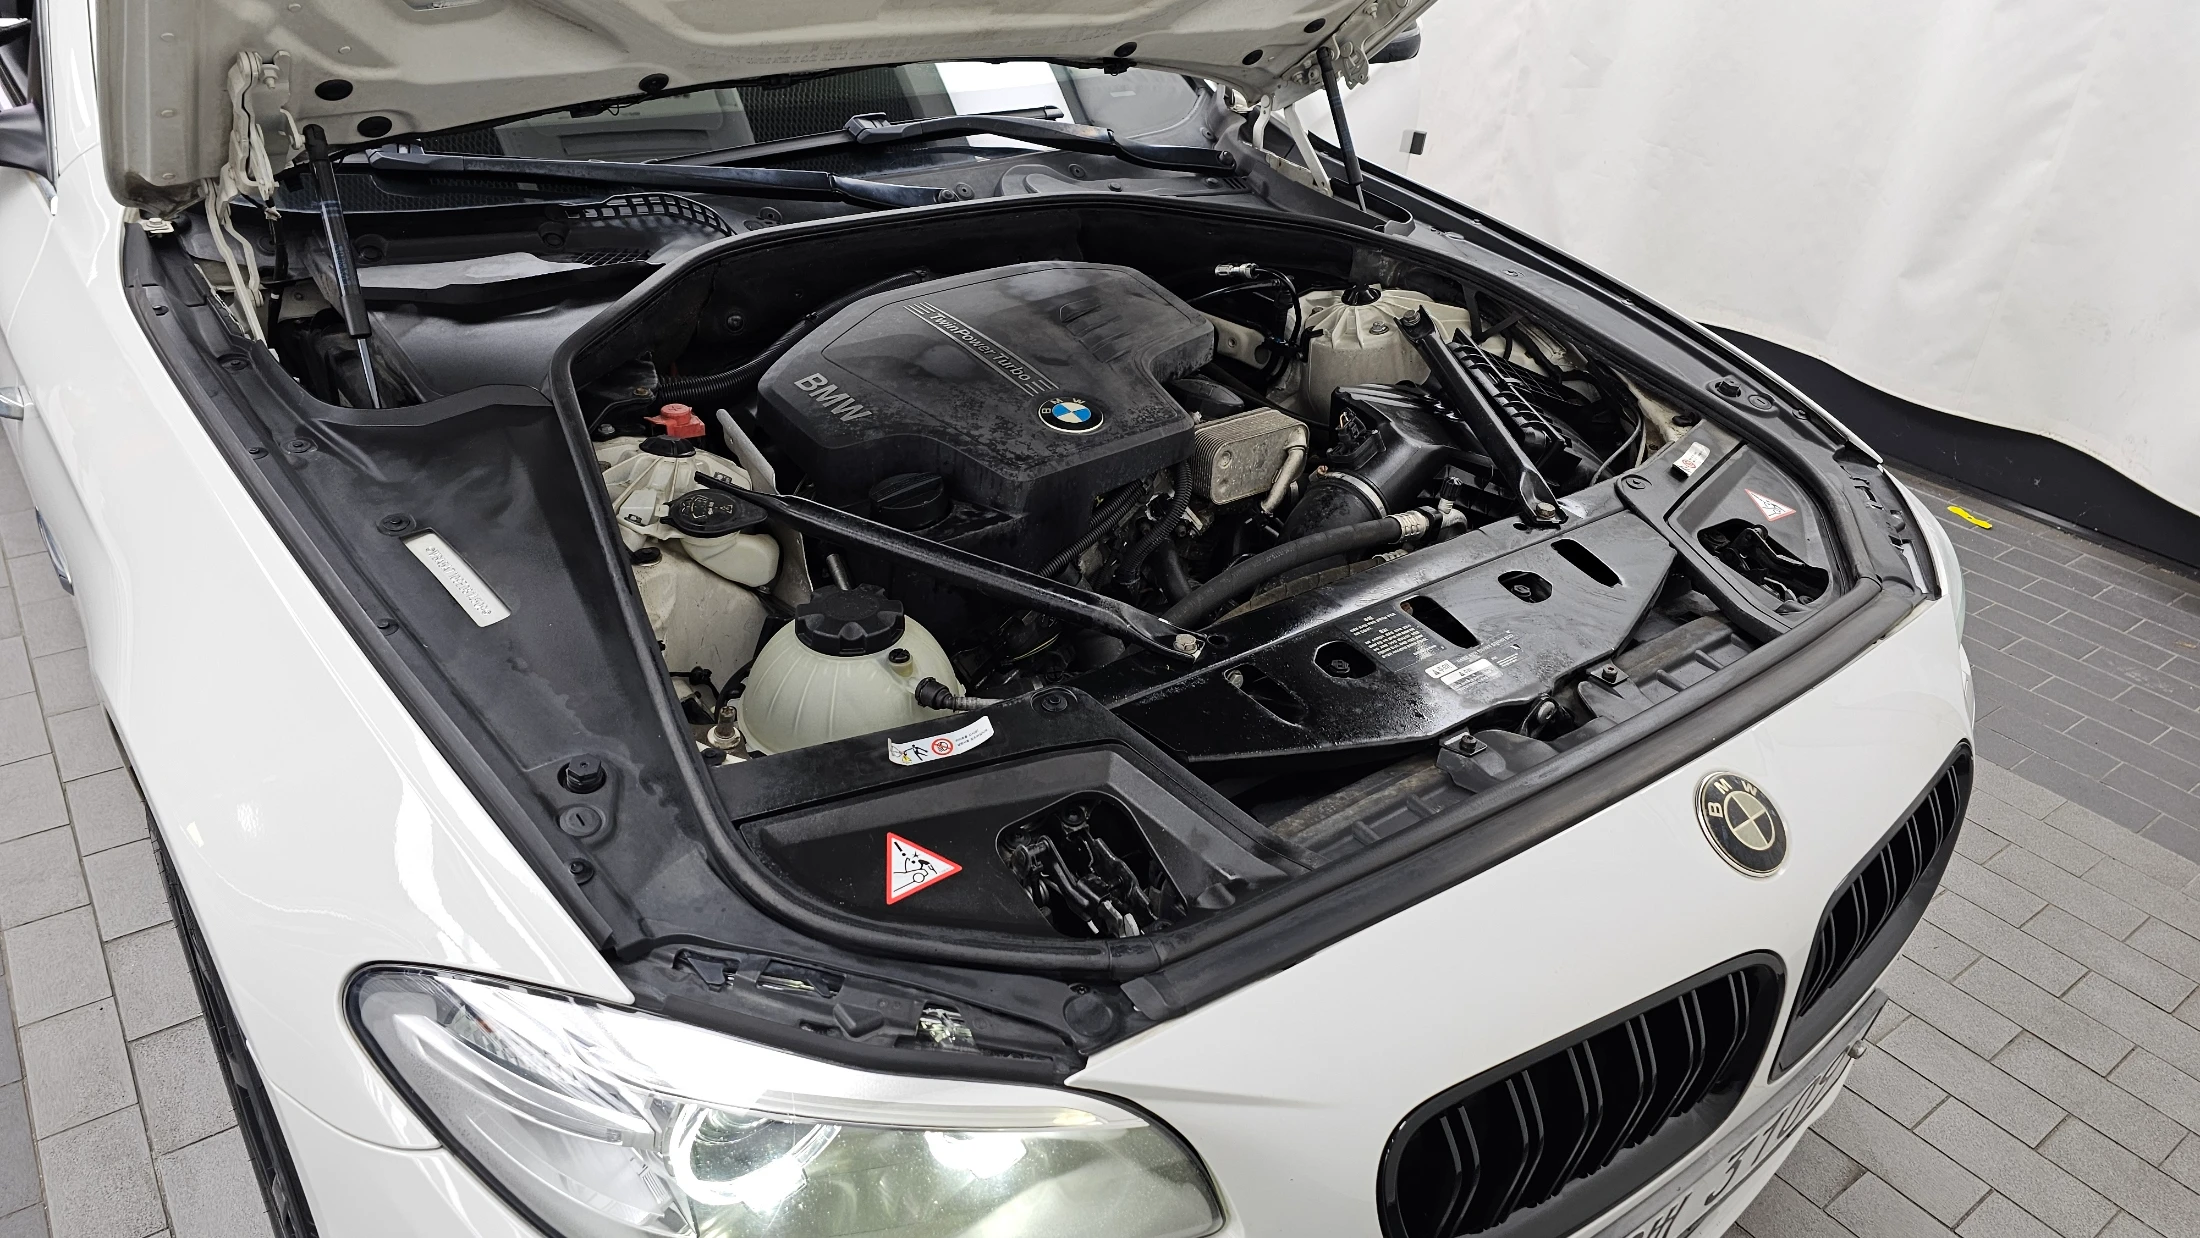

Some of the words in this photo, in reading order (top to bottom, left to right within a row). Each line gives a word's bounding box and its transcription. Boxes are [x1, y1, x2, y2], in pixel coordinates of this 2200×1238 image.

[930, 313, 996, 355] TwinPower
[993, 353, 1031, 381] Turbo
[794, 372, 873, 422] BMW
[1041, 397, 1086, 414] BMW
[1707, 778, 1758, 818] BMW
